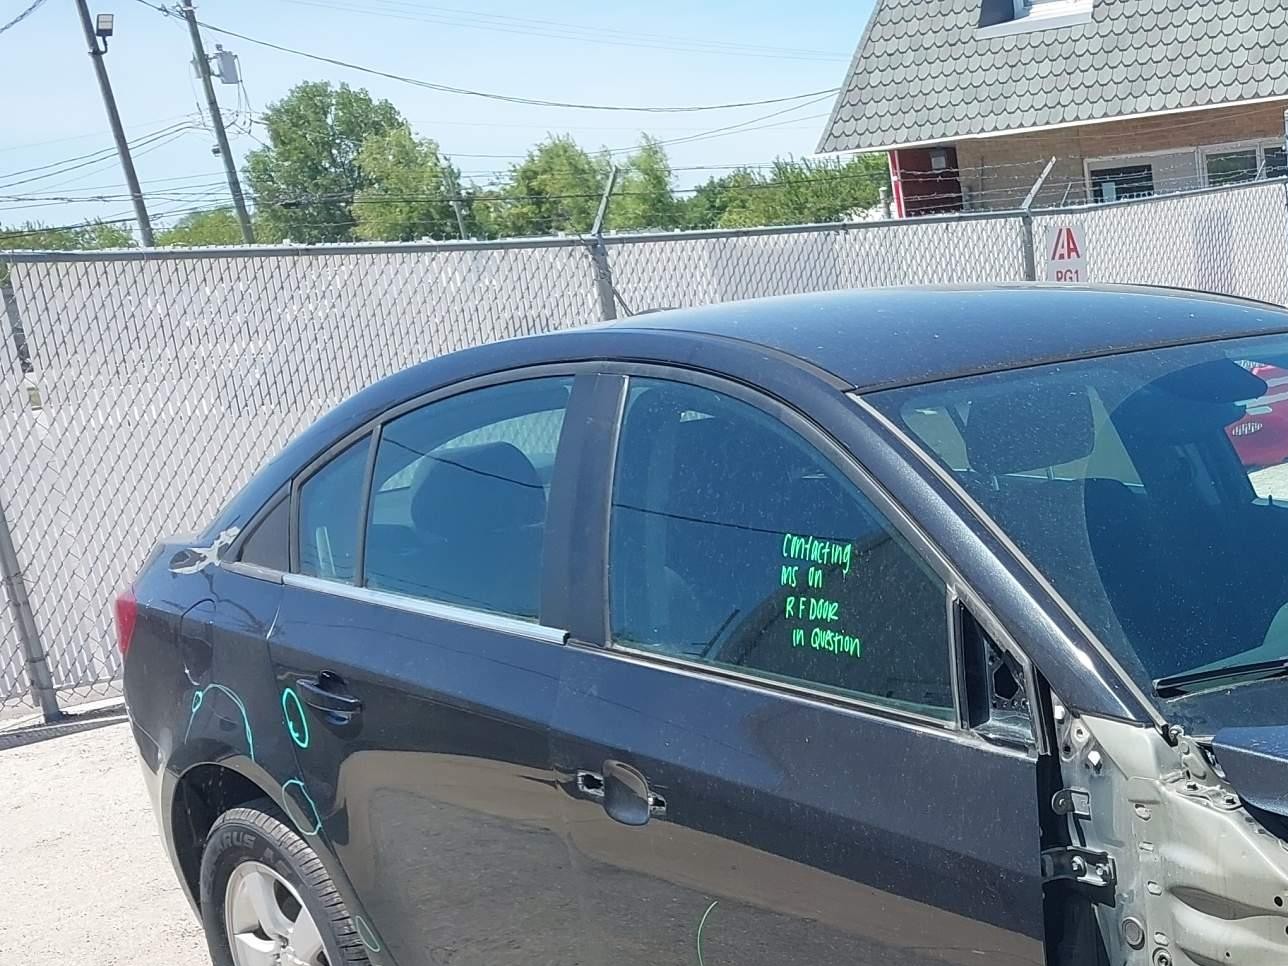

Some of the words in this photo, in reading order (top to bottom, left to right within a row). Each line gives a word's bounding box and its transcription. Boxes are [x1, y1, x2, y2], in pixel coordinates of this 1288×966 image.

[808, 566, 822, 588] on
[786, 596, 795, 618] R
[799, 597, 807, 619] F
